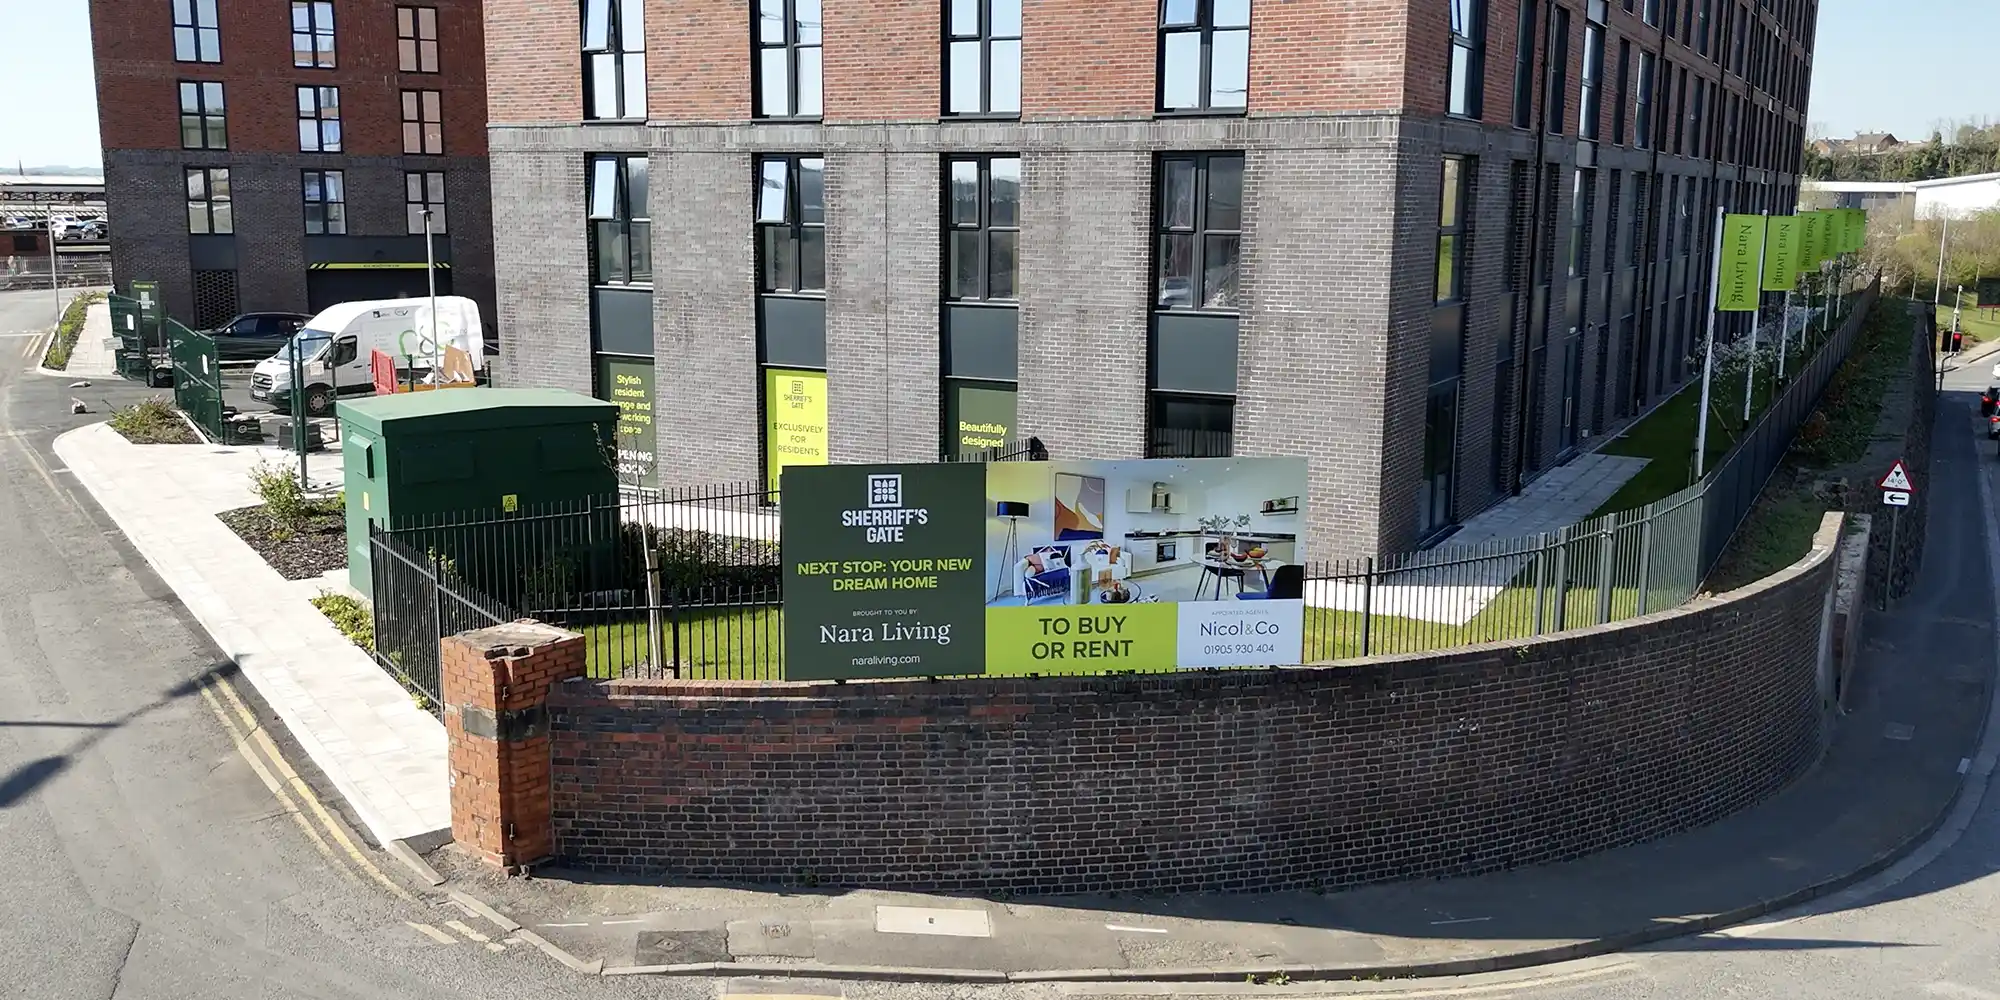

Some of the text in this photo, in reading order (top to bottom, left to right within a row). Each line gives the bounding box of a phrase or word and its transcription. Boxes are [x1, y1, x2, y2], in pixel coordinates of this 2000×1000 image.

[1772, 223, 1791, 284] Nara Living
[1731, 224, 1752, 302] Nara Living
[616, 374, 642, 386] Stylish
[614, 388, 645, 398] resident
[636, 402, 651, 411] and
[773, 422, 823, 433] EXCLUSIVELY
[959, 421, 1008, 436] Beautifully
[791, 435, 806, 443] FOR
[962, 435, 1004, 449] designed
[618, 449, 653, 462] PENNG
[777, 445, 820, 456] RESIDENTS
[841, 508, 928, 526] SHERRIFF'S
[866, 527, 904, 543] GATE
[797, 558, 972, 575] NEXT STOP: YOUR NEW
[833, 576, 938, 591] DREAM HOME
[852, 609, 882, 617] BROUGHT
[1038, 616, 1127, 635] TO BUY
[1200, 620, 1279, 636] Nicol&Co
[819, 621, 952, 645] Nara Living
[1031, 640, 1134, 659] OR RENT
[1204, 644, 1274, 655] 01905 930 404
[852, 654, 921, 666] naraliving.com
